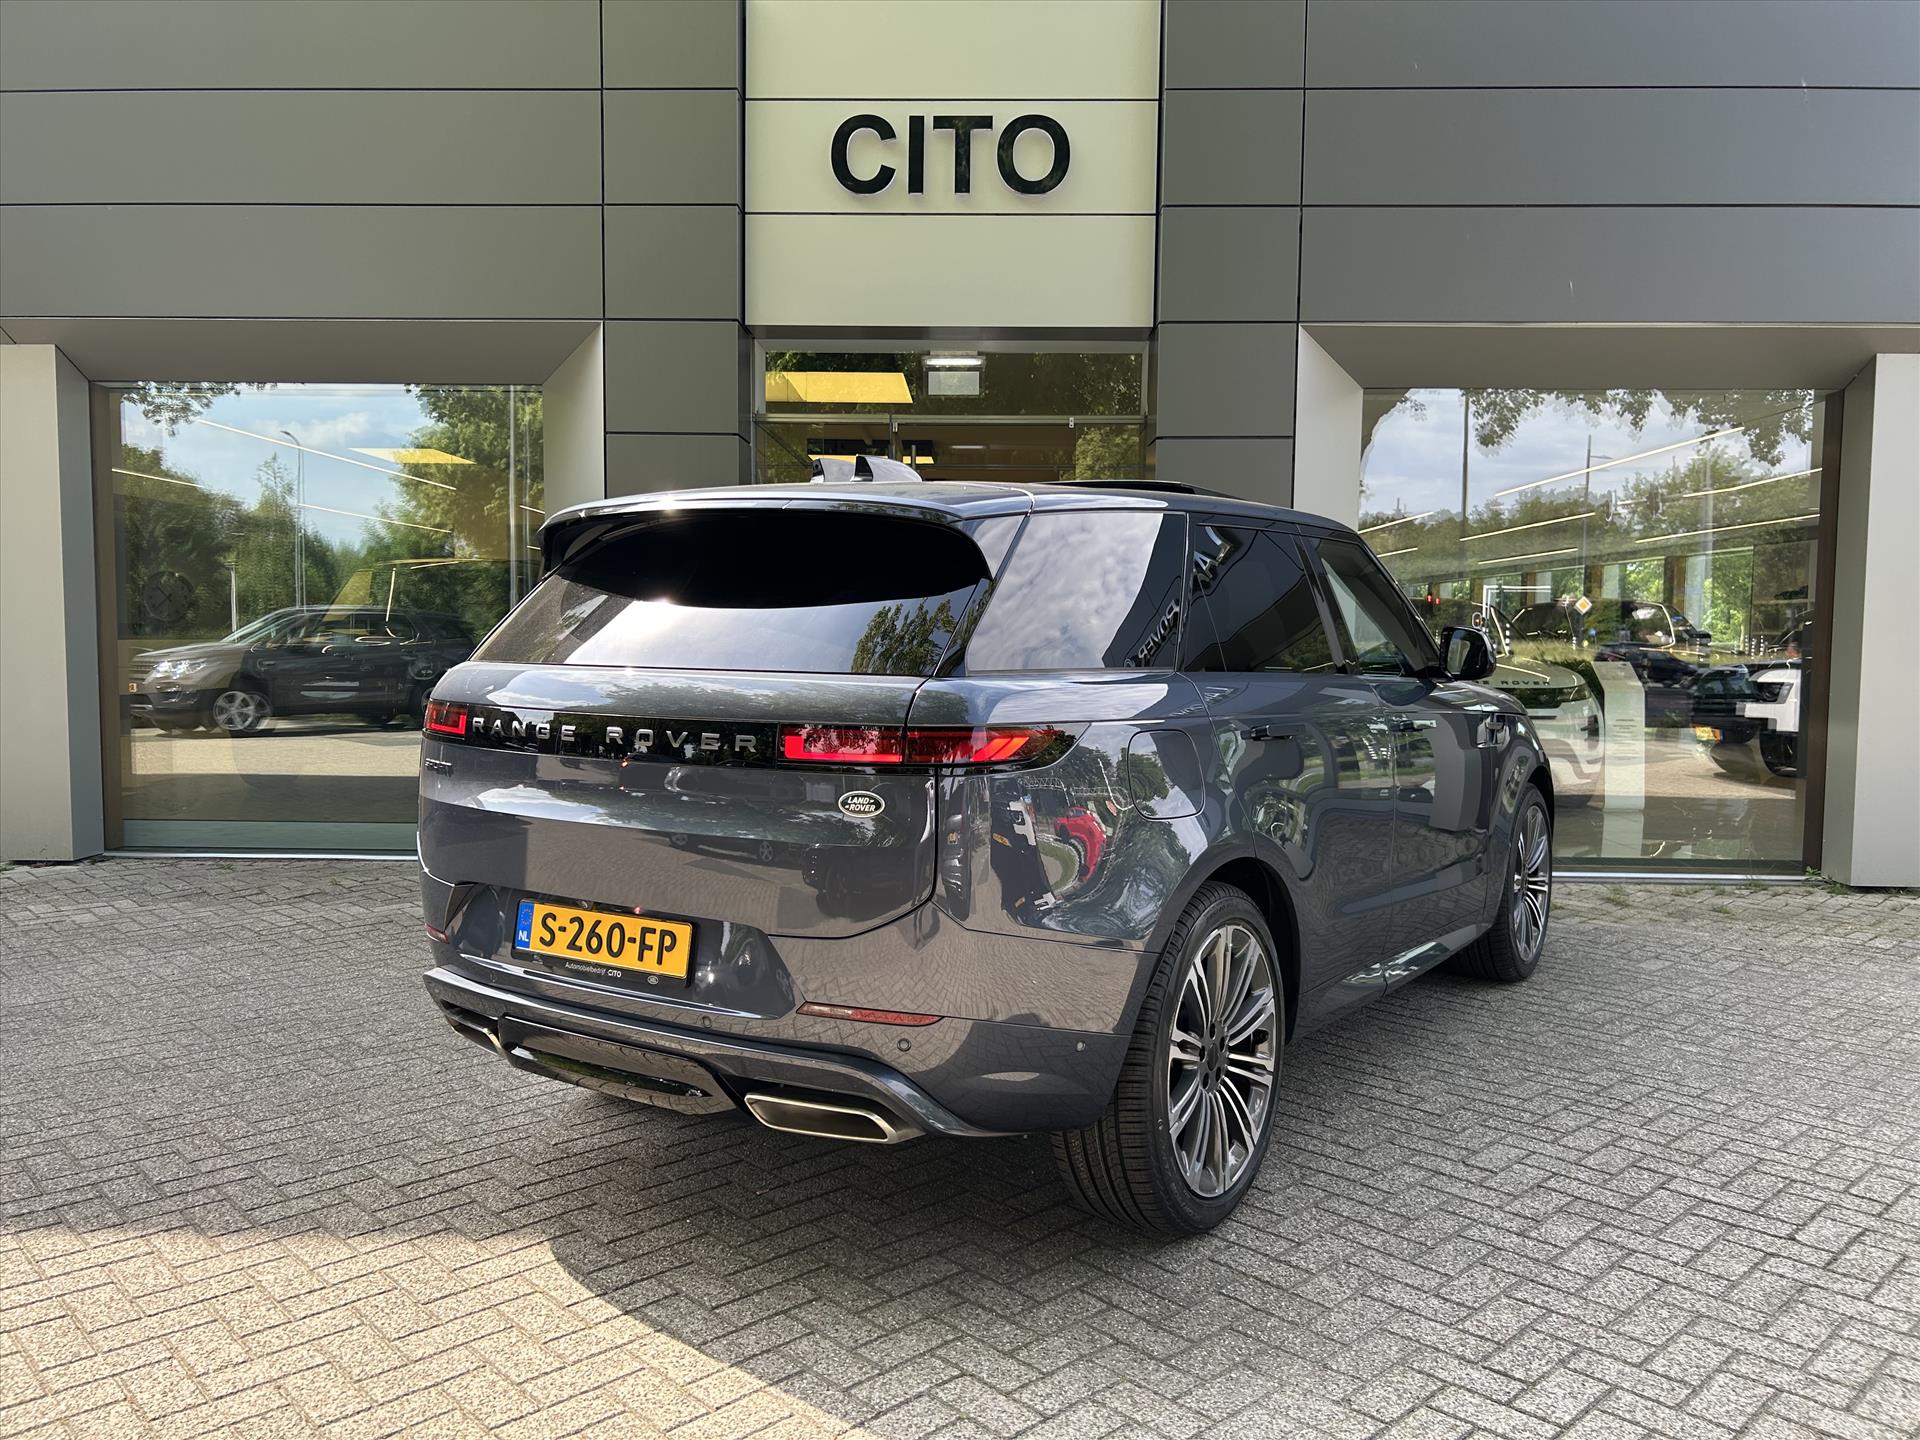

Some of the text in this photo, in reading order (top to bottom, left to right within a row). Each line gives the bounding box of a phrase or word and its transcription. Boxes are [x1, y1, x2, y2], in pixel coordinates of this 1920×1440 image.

[830, 113, 1071, 195] CITO
[472, 716, 757, 753] RANGE ROVER
[847, 796, 870, 804] LAND
[849, 803, 876, 812] ROVER
[518, 929, 530, 942] NL
[539, 912, 677, 966] S-260-FP
[607, 969, 622, 978] CITO
